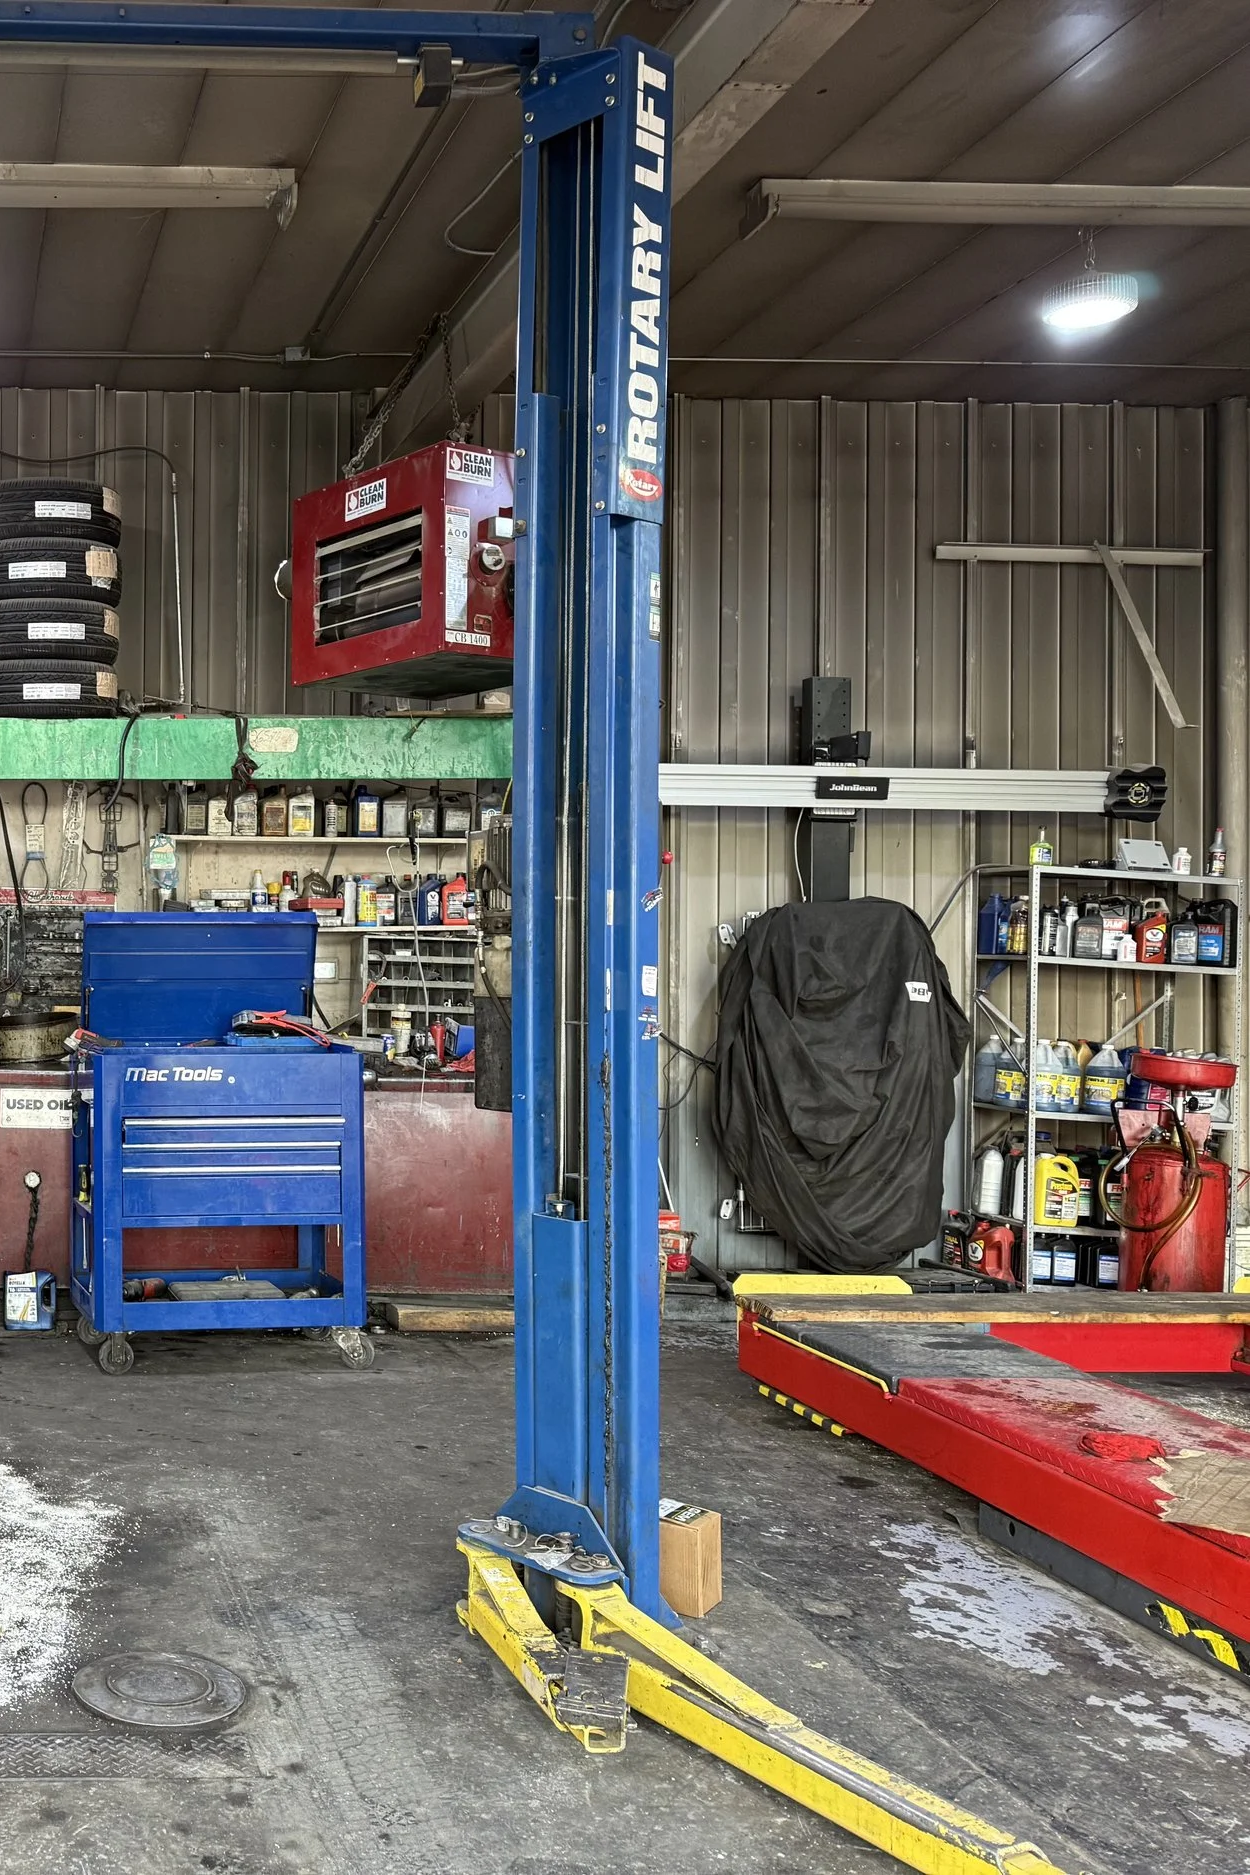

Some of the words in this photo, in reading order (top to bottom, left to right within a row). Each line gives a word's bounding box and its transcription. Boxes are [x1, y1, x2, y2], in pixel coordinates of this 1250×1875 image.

[635, 52, 668, 193] LIFT
[627, 203, 663, 464] ROTARY
[463, 453, 492, 467] CLEAN
[463, 464, 492, 478] BURN
[359, 481, 384, 497] CLEAN
[625, 469, 659, 496] Rotary
[359, 491, 384, 508] BURN
[454, 632, 467, 643] CB
[469, 634, 488, 645] 1400
[829, 783, 877, 792] JohnBean
[1198, 925, 1219, 934] RAM
[125, 1067, 168, 1082] Mac
[172, 1066, 224, 1082] Tools
[6, 1099, 44, 1111] USED
[47, 1099, 72, 1111] OIL
